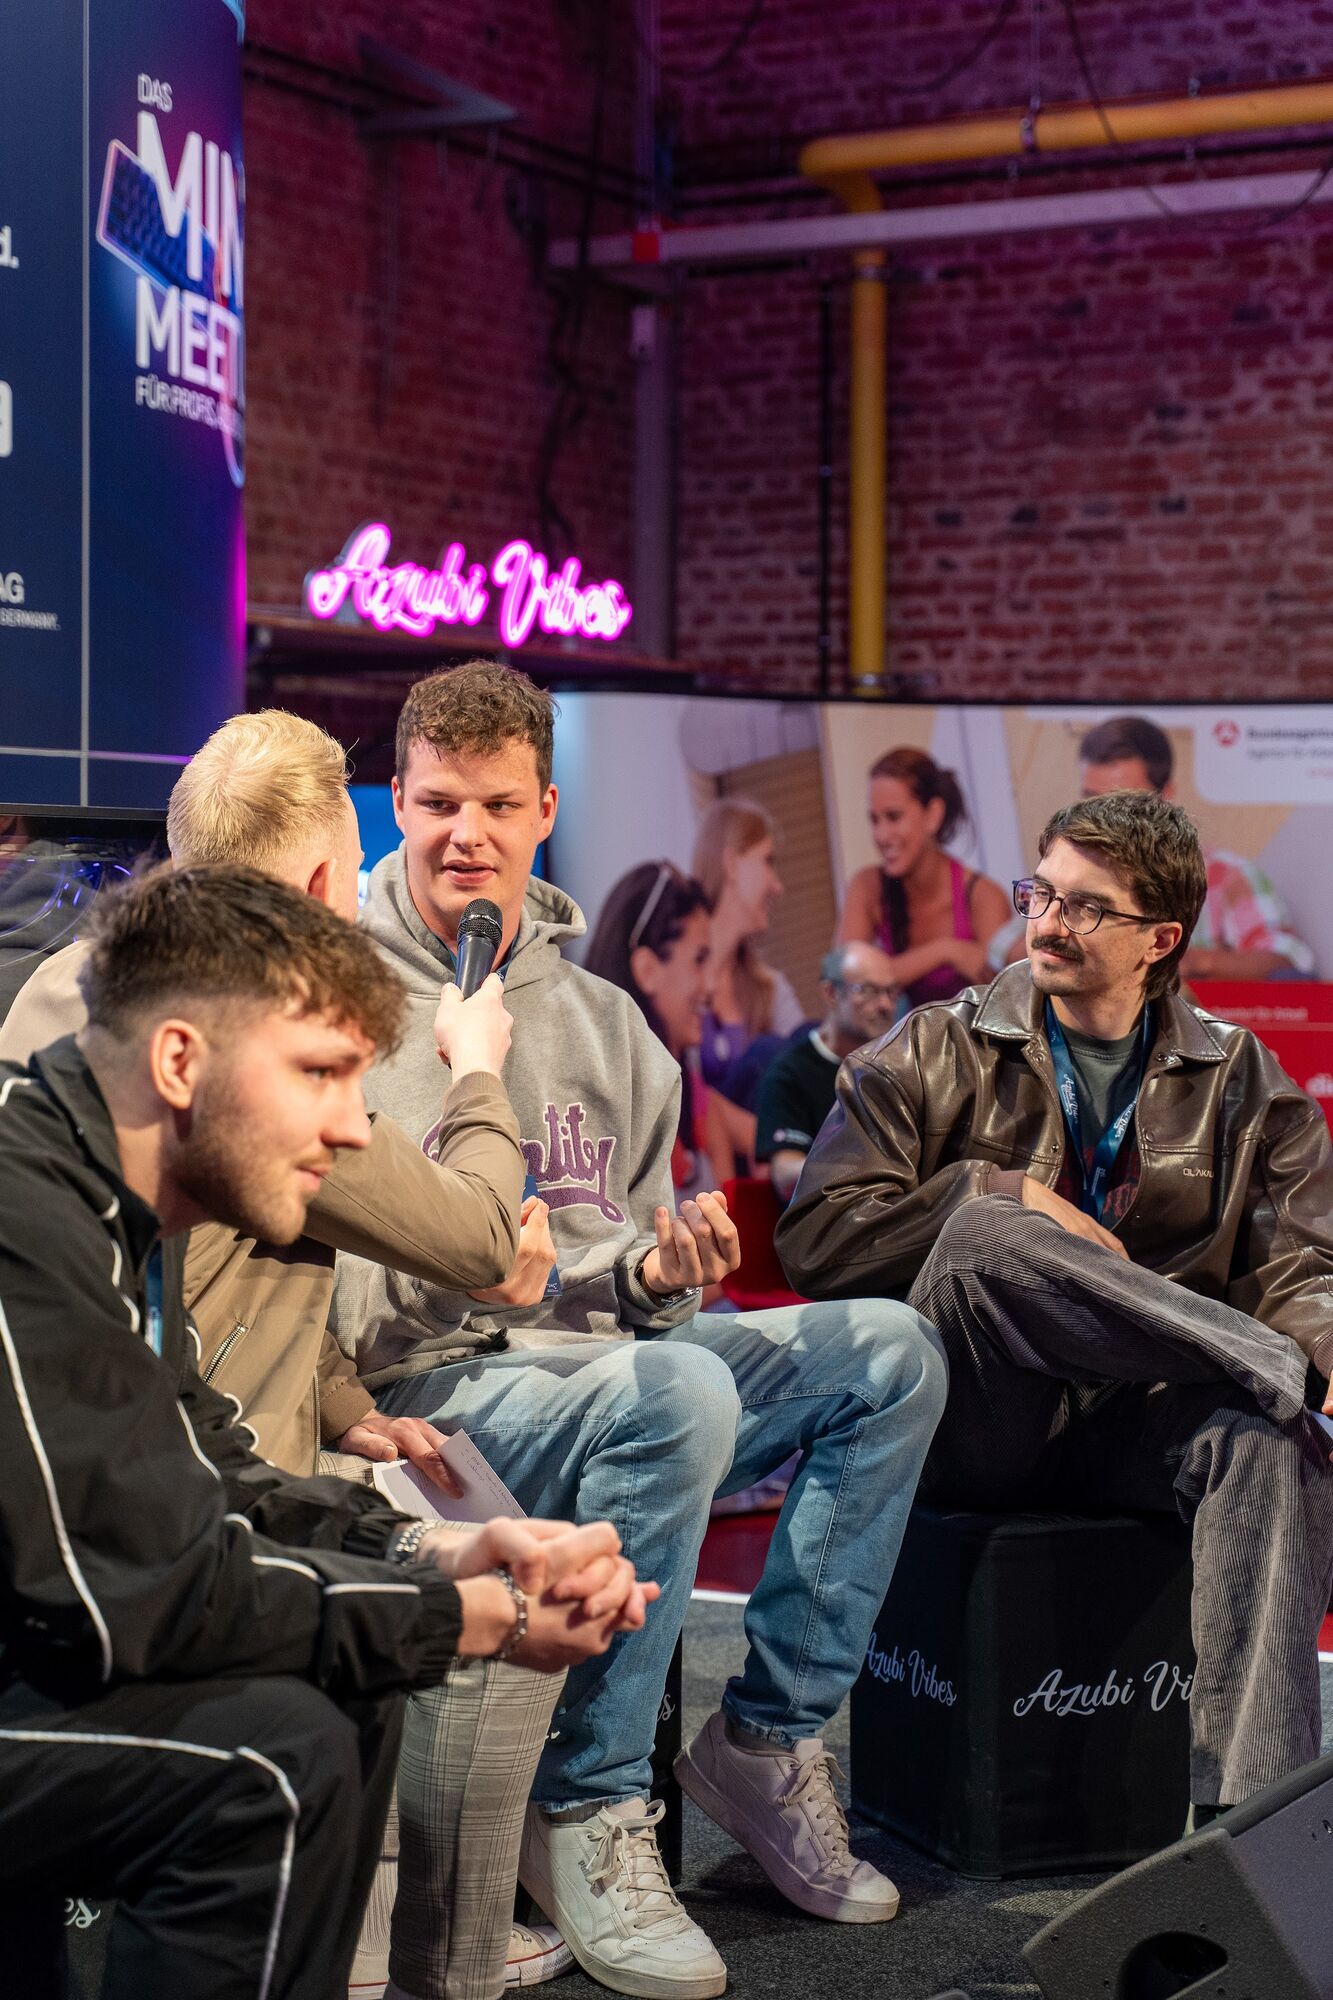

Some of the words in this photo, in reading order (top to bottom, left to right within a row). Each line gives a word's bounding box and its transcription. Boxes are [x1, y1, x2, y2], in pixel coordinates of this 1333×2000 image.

[137, 73, 173, 113] DAS
[308, 522, 489, 638] Azubi
[492, 539, 633, 648] Vibes
[908, 1649, 957, 1707] Vibes
[1013, 1668, 1136, 1717] Azubi
